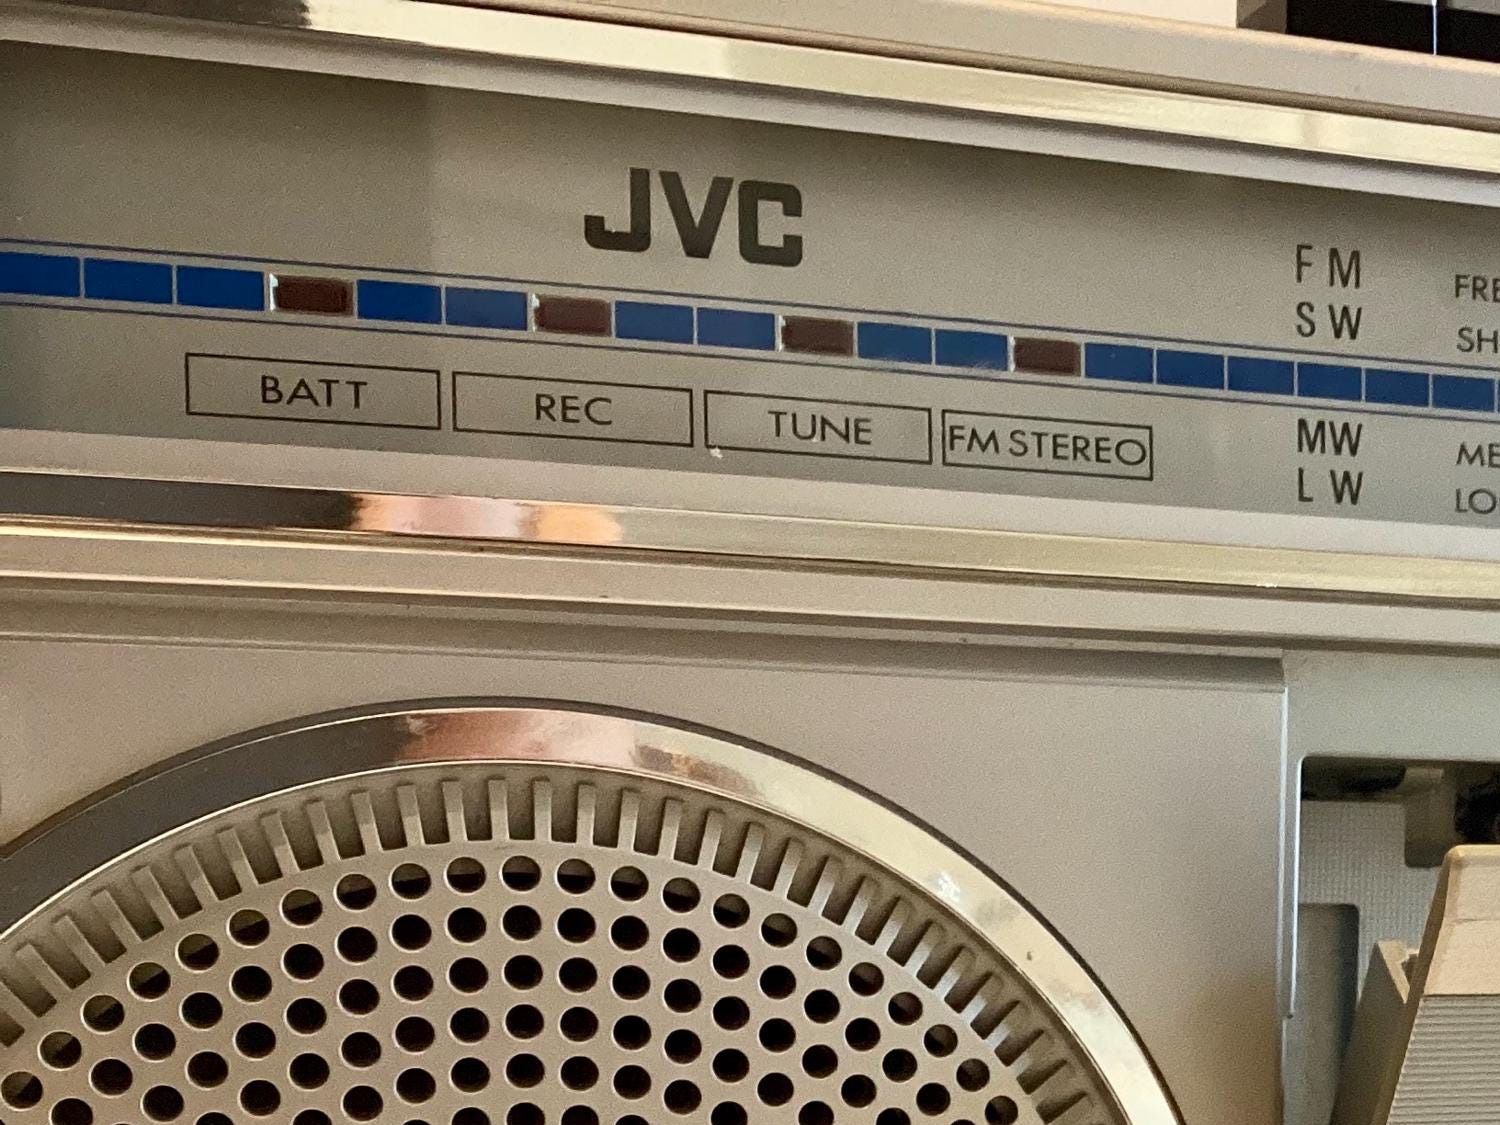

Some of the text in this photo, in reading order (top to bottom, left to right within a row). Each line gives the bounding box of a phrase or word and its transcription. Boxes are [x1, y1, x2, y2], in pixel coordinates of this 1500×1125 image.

[583, 166, 804, 269] JVC
[1295, 244, 1362, 290] FM
[1295, 302, 1362, 341] SW
[260, 374, 369, 410] BATT
[534, 395, 614, 427] REC
[768, 409, 873, 446] TUNE
[948, 424, 1148, 467] FM STEREO
[1296, 418, 1363, 458] MW
[1297, 468, 1364, 507] LW
